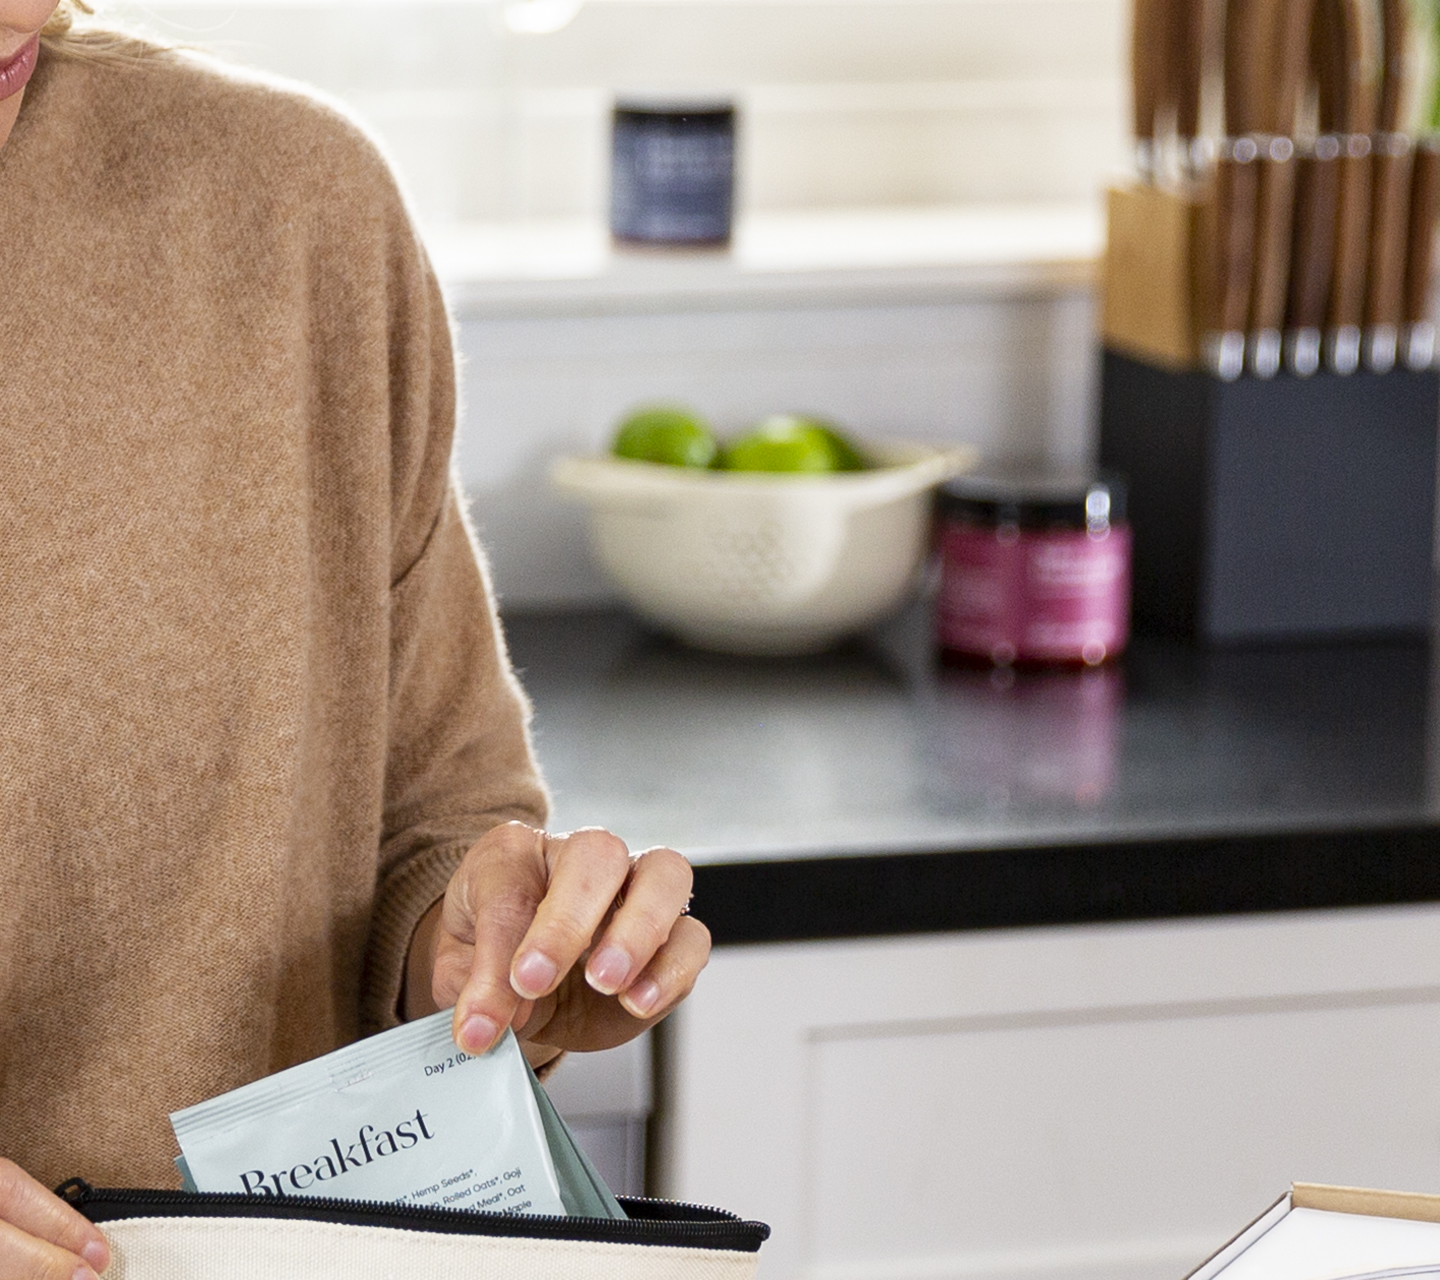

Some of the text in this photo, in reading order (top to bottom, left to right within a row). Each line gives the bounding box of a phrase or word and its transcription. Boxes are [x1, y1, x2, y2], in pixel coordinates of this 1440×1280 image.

[423, 1062, 446, 1077] Day
[446, 1057, 455, 1069] 2
[239, 1108, 436, 1198] Breakfast
[411, 1184, 440, 1200] Hemp
[442, 1187, 472, 1205] Rolled
[503, 1166, 523, 1182] Goji
[507, 1183, 526, 1197] Oat
